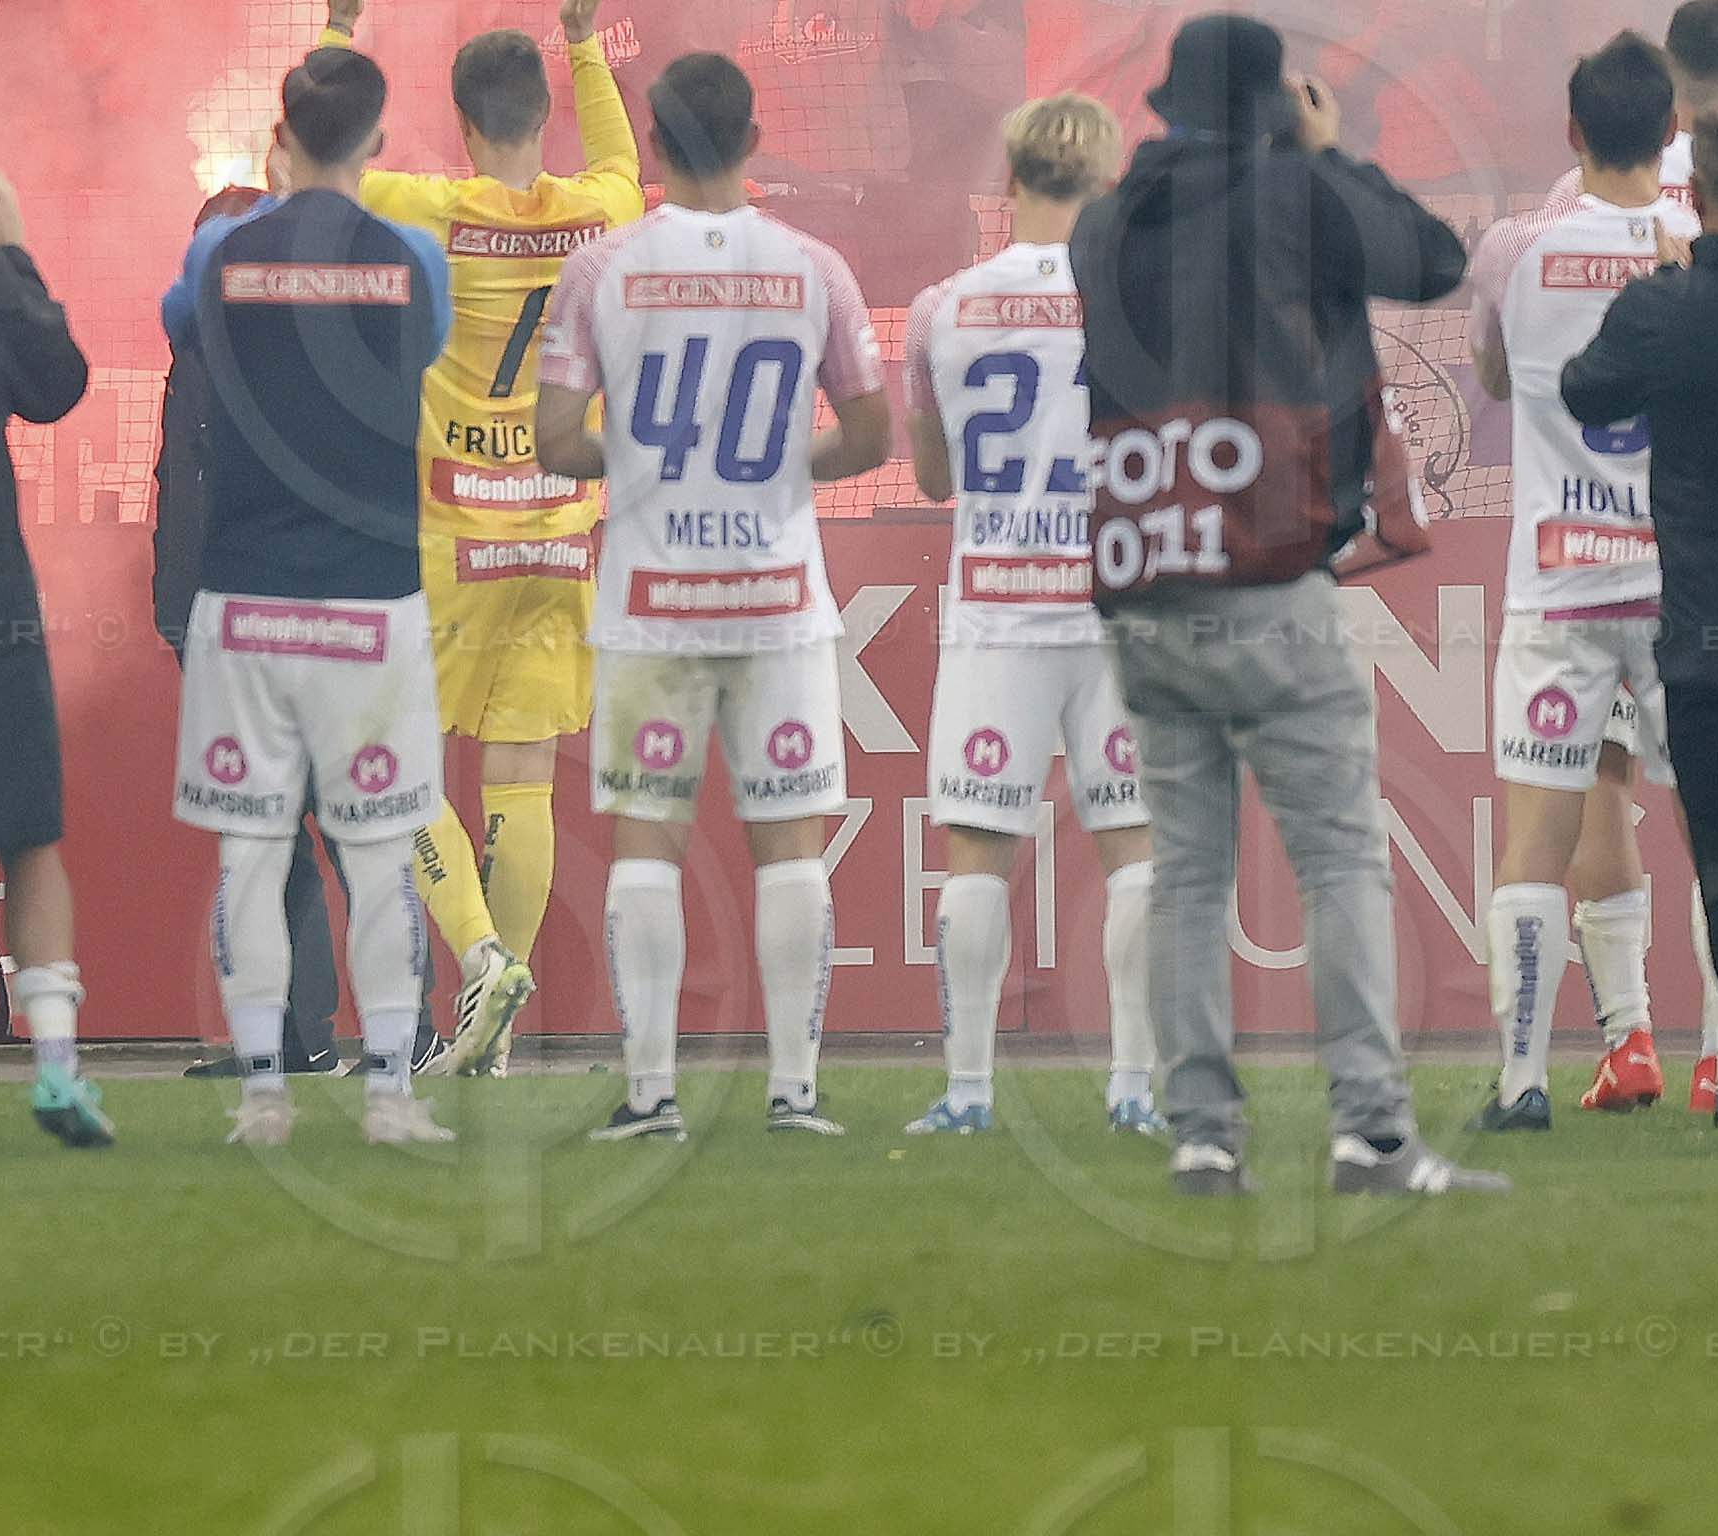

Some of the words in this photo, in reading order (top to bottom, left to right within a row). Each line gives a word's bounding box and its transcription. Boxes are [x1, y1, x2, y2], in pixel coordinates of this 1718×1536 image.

[632, 336, 803, 483] 40
[446, 419, 532, 458] FRÜC
[666, 511, 772, 550] MEISL
